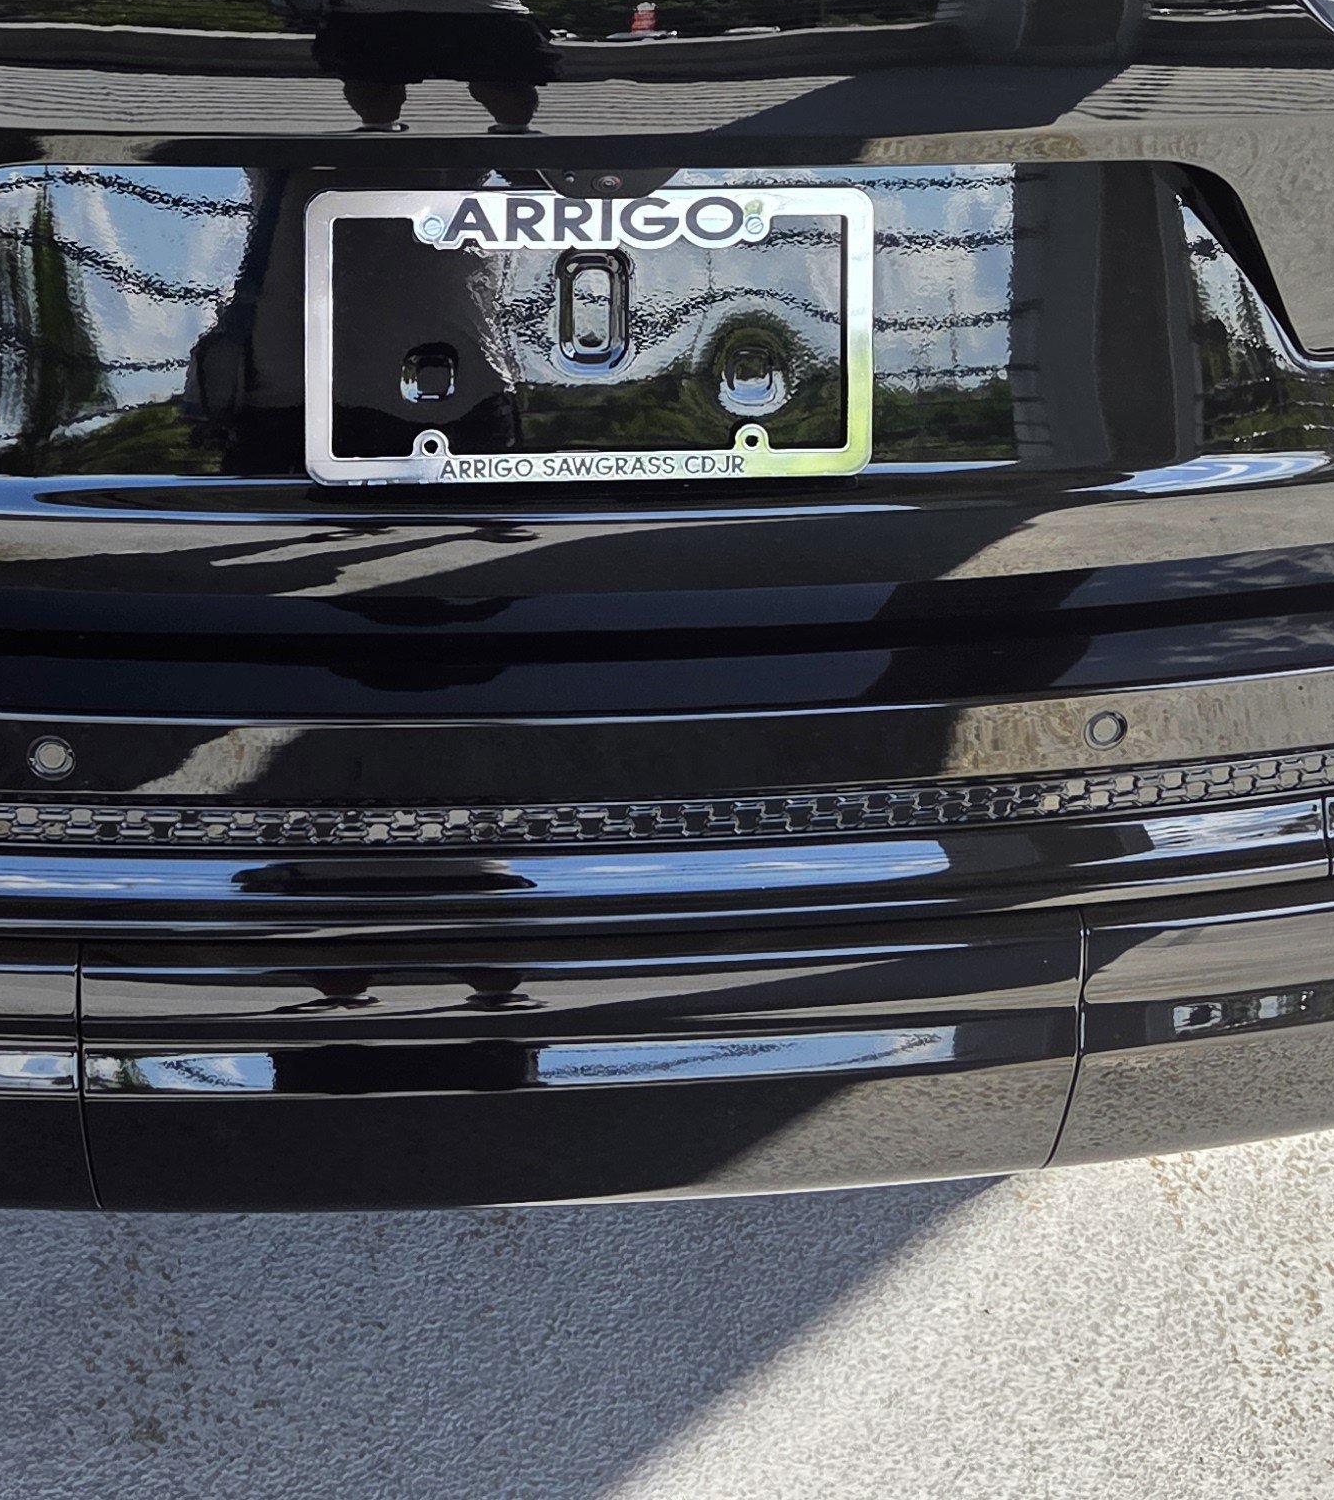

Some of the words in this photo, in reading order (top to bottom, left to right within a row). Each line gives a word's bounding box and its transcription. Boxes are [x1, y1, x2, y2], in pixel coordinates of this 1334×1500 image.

[443, 196, 744, 243] ARRIGO
[440, 458, 533, 479] ARRIGO
[542, 455, 676, 477] SAWGRASS
[684, 455, 746, 475] CDJR
